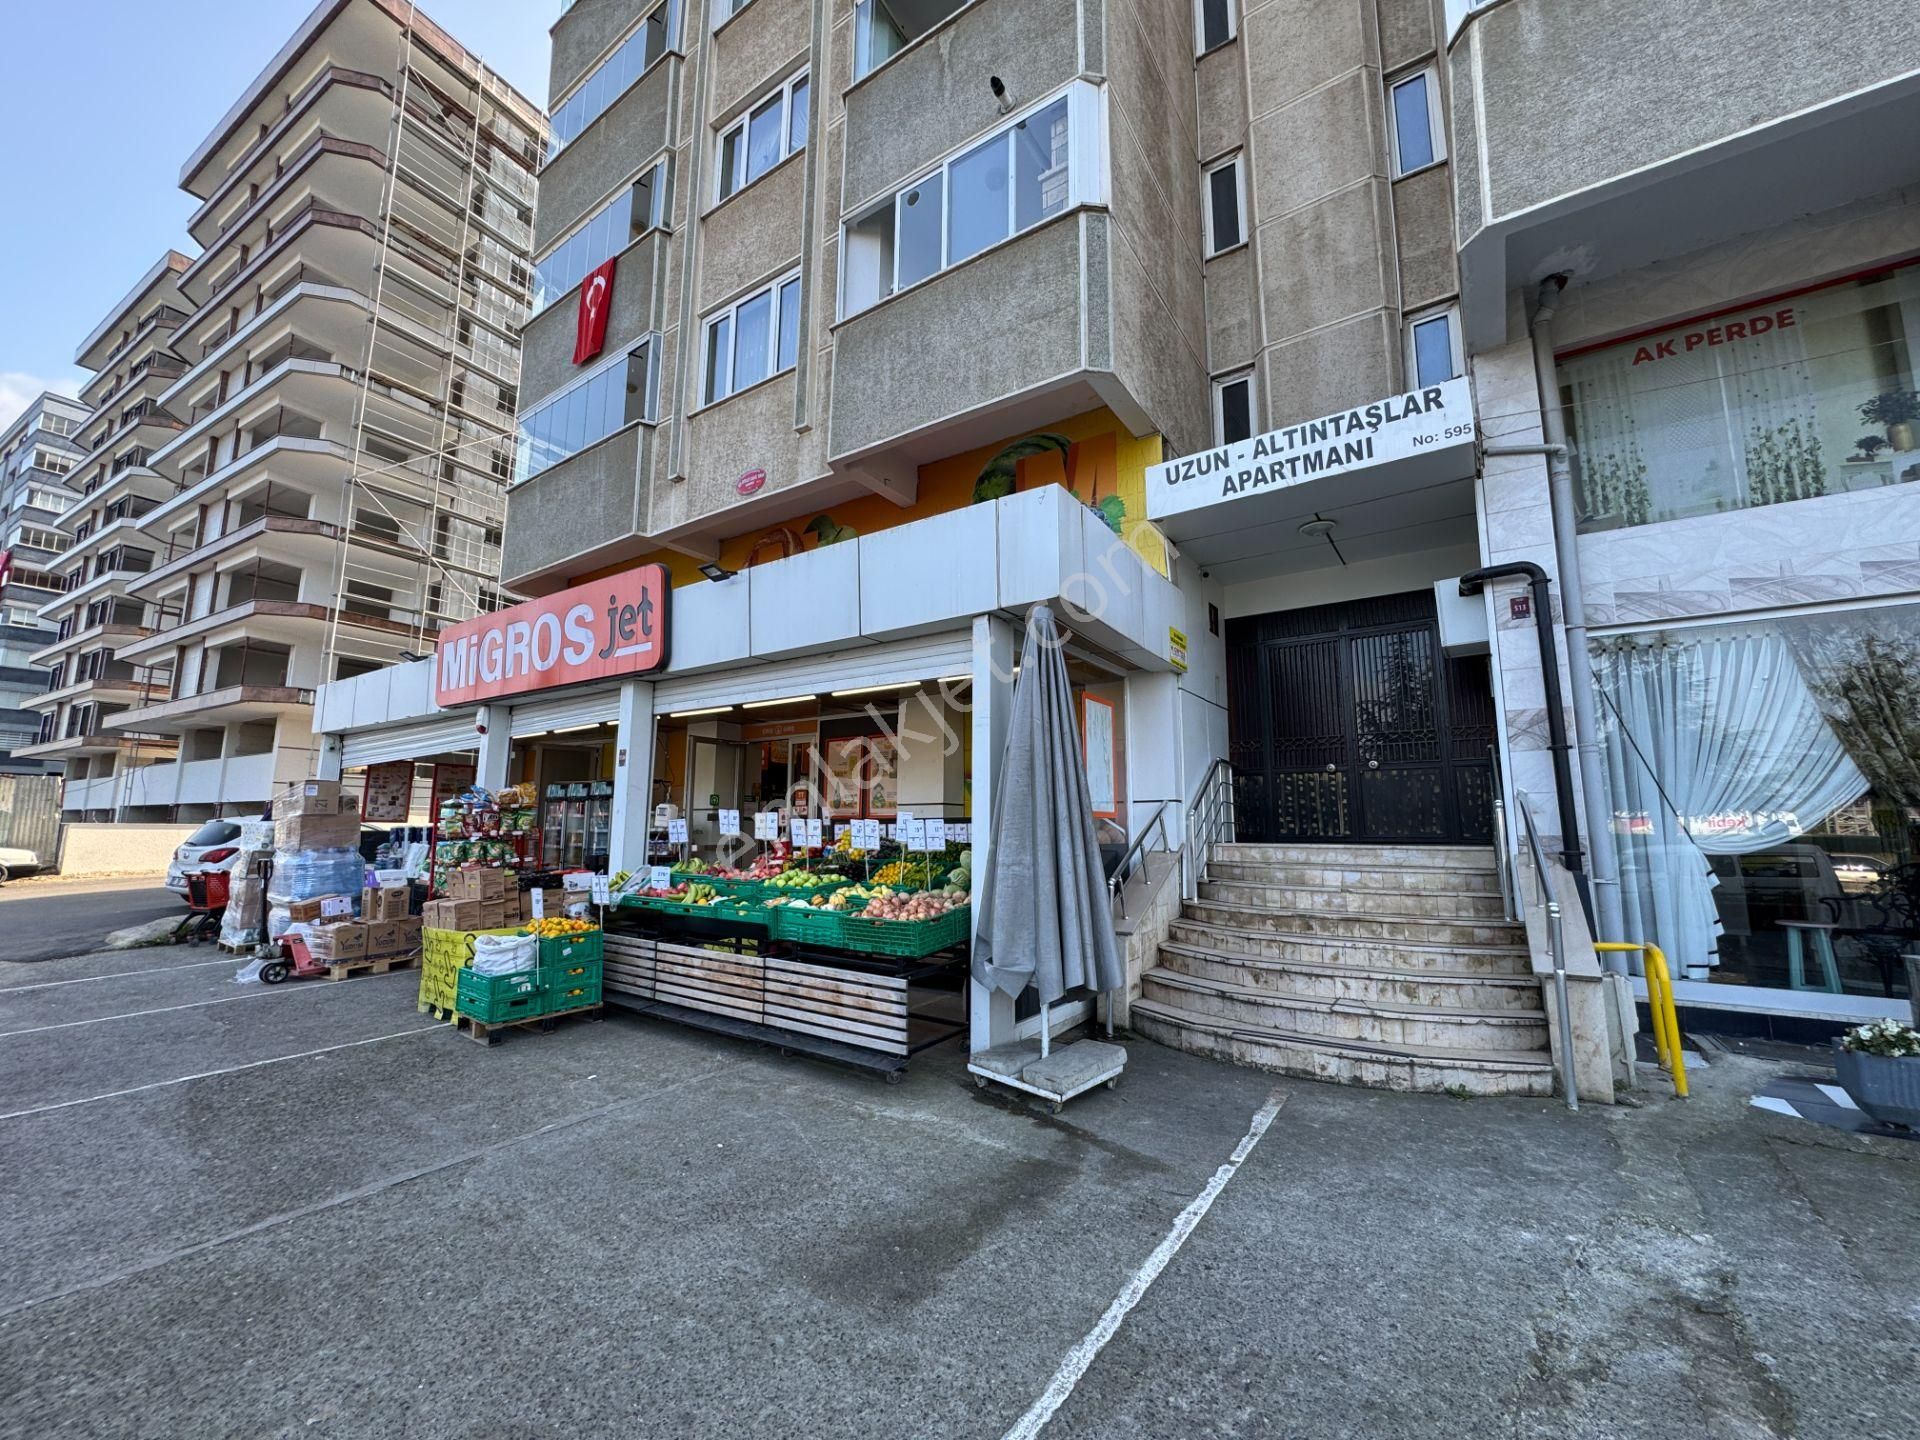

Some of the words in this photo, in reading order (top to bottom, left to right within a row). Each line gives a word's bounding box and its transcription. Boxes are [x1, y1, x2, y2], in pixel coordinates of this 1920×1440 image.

[1632, 339, 1677, 366] AK
[1685, 308, 1795, 352] PERDE
[1165, 449, 1230, 486] UZUN
[1253, 387, 1445, 460] ALTINTAŞLAR
[1413, 432, 1439, 447] No:
[1444, 423, 1472, 440] 595
[1222, 437, 1375, 496] APARTMANI
[440, 603, 595, 692] MiGROS
[598, 585, 654, 659] jet
